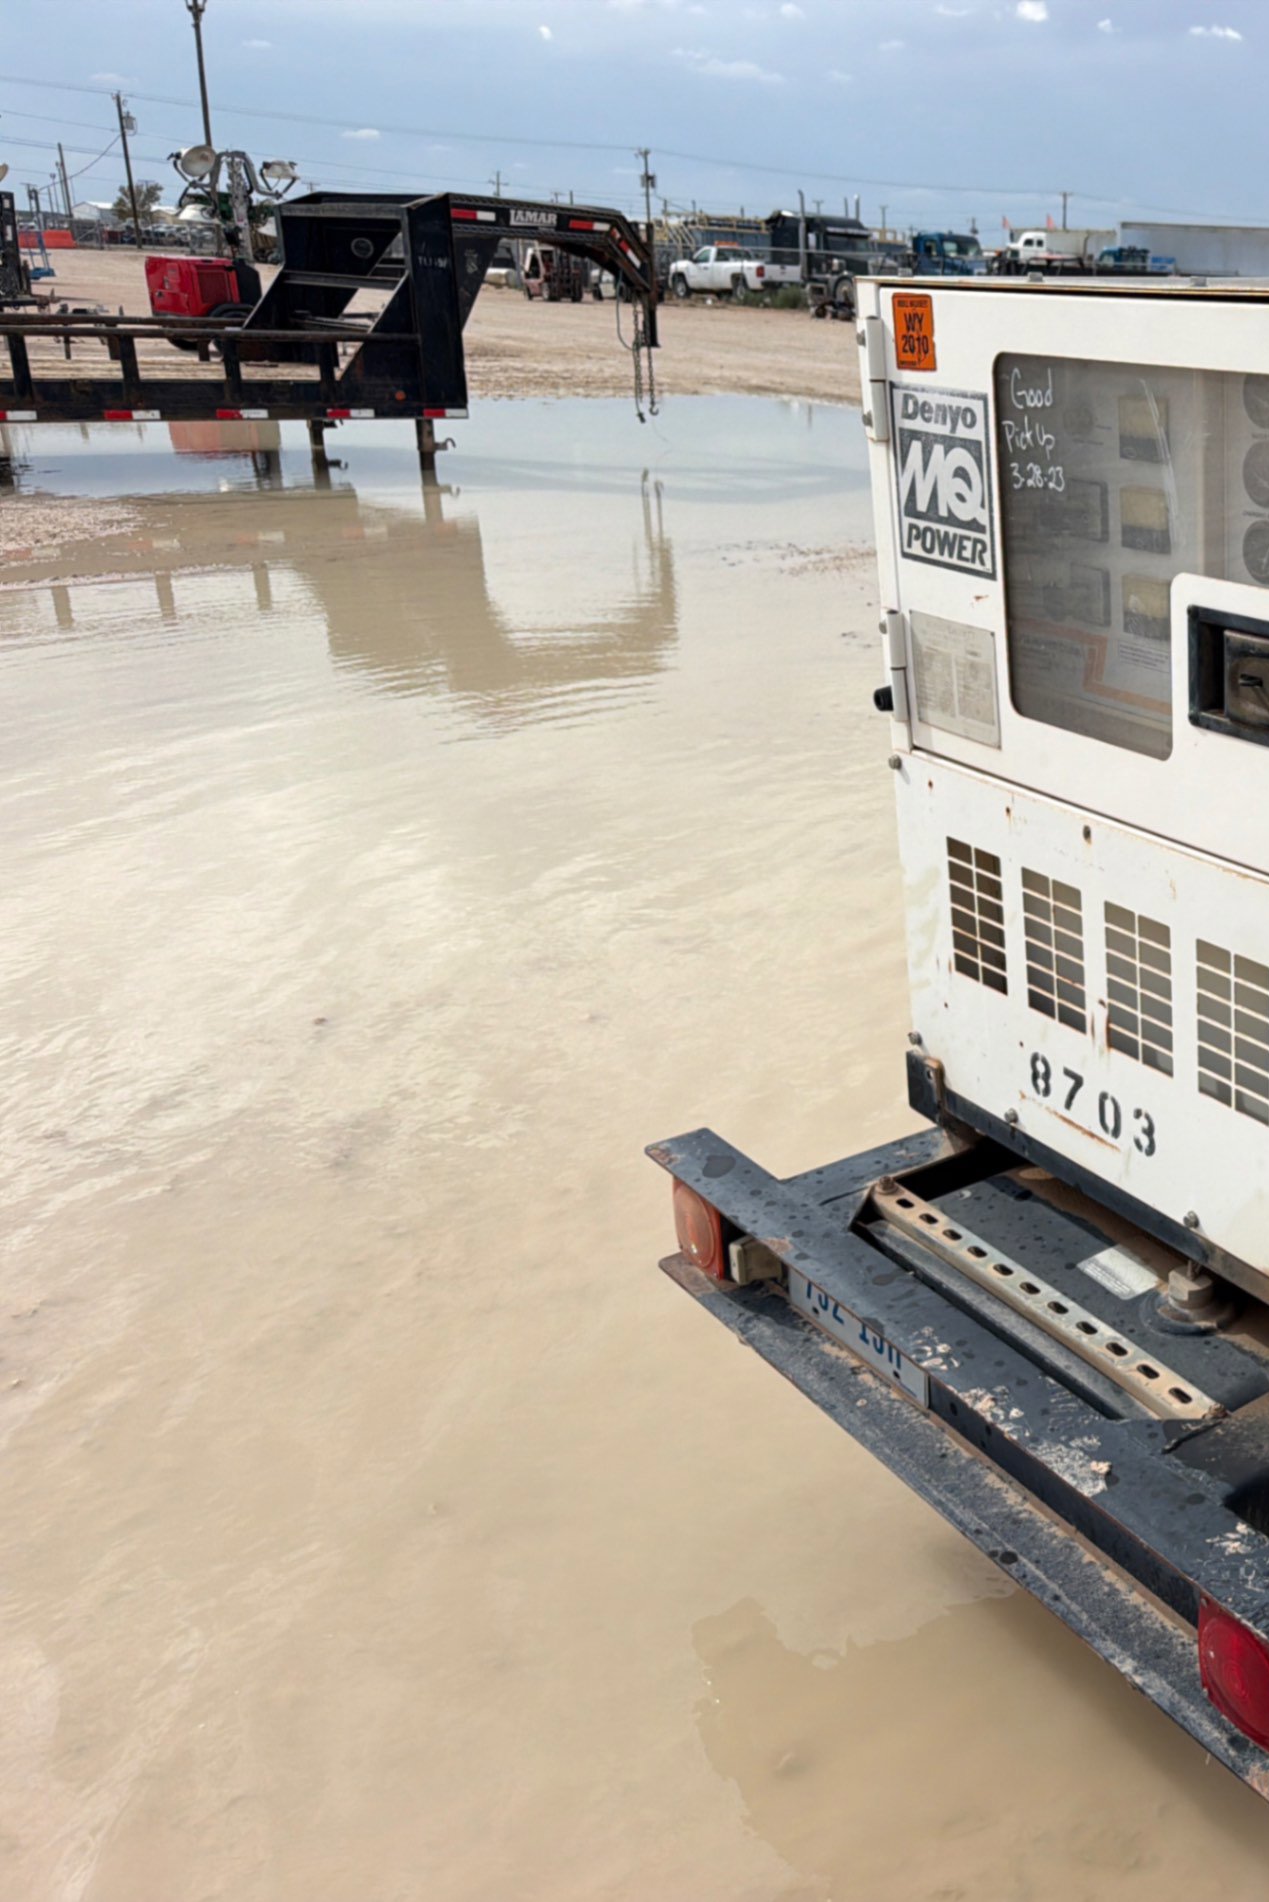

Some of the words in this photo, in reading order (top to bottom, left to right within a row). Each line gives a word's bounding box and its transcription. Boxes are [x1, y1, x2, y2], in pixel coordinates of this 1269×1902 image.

[509, 209, 558, 226] LAMAR
[904, 312, 924, 332] WY
[901, 334, 929, 354] 2010
[1010, 367, 1053, 409] Good
[901, 392, 978, 434] Denyo
[1001, 415, 1034, 453] Pick
[901, 439, 988, 523] MQ
[907, 522, 987, 567] POWER
[1030, 1052, 1156, 1157] 8703
